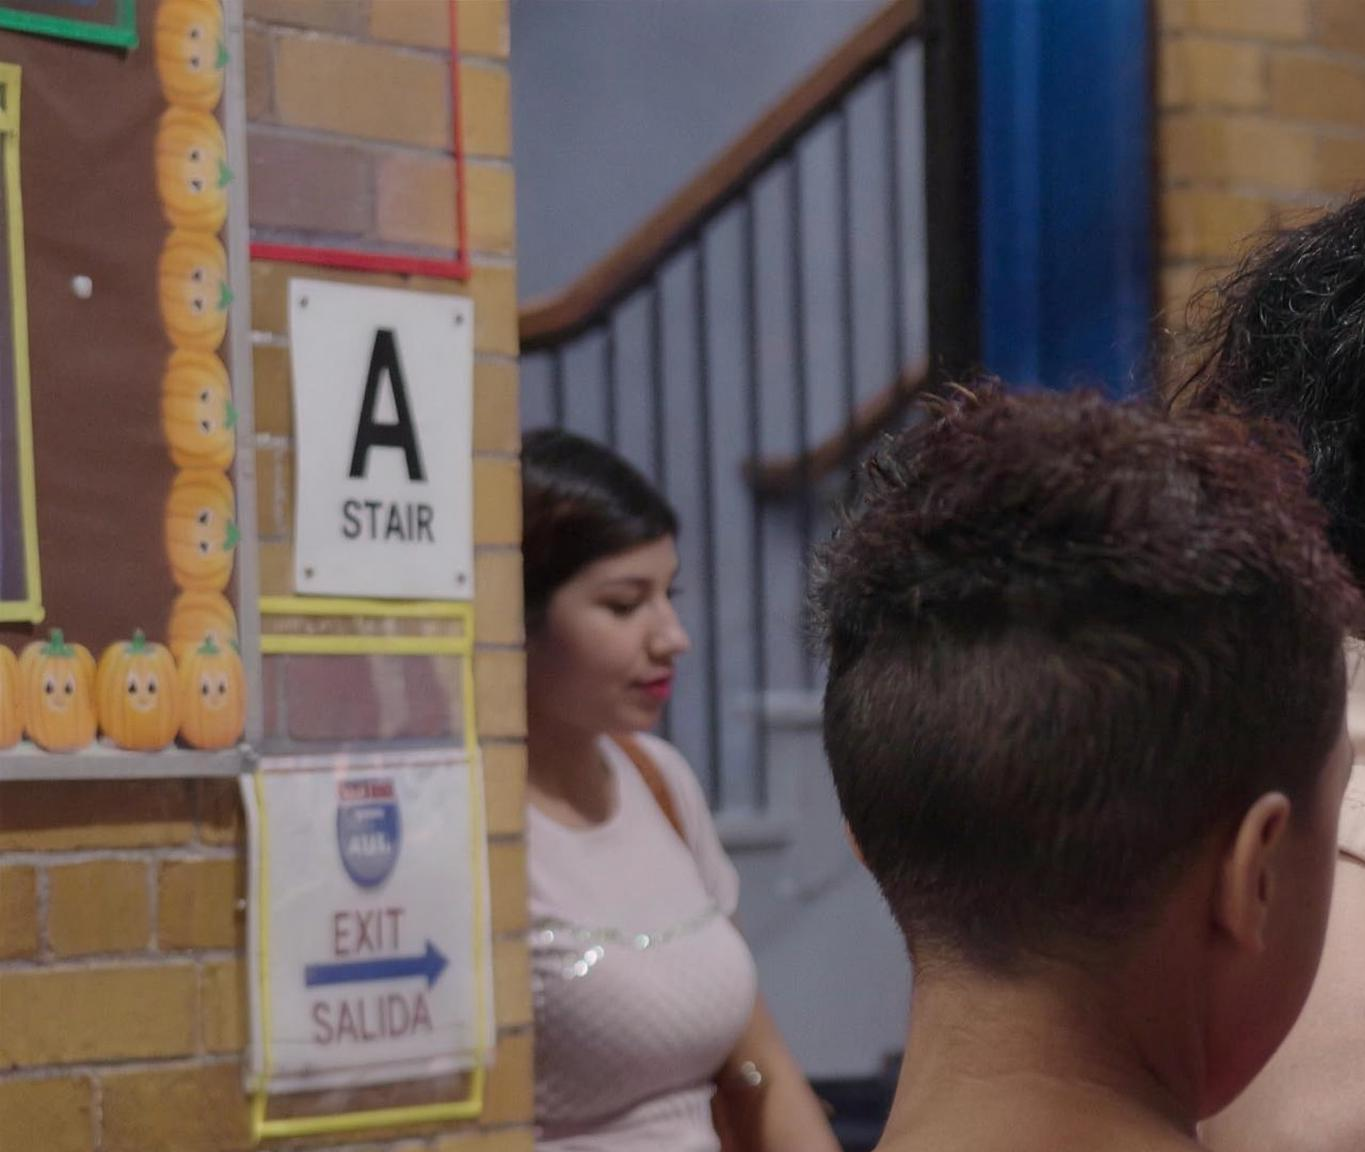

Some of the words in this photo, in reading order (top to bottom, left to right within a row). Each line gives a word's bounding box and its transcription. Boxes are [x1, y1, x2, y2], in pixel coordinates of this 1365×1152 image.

[348, 327, 427, 483] A
[342, 499, 435, 543] STAIR
[333, 906, 405, 957] EXIT
[311, 991, 434, 1046] SALIDA
